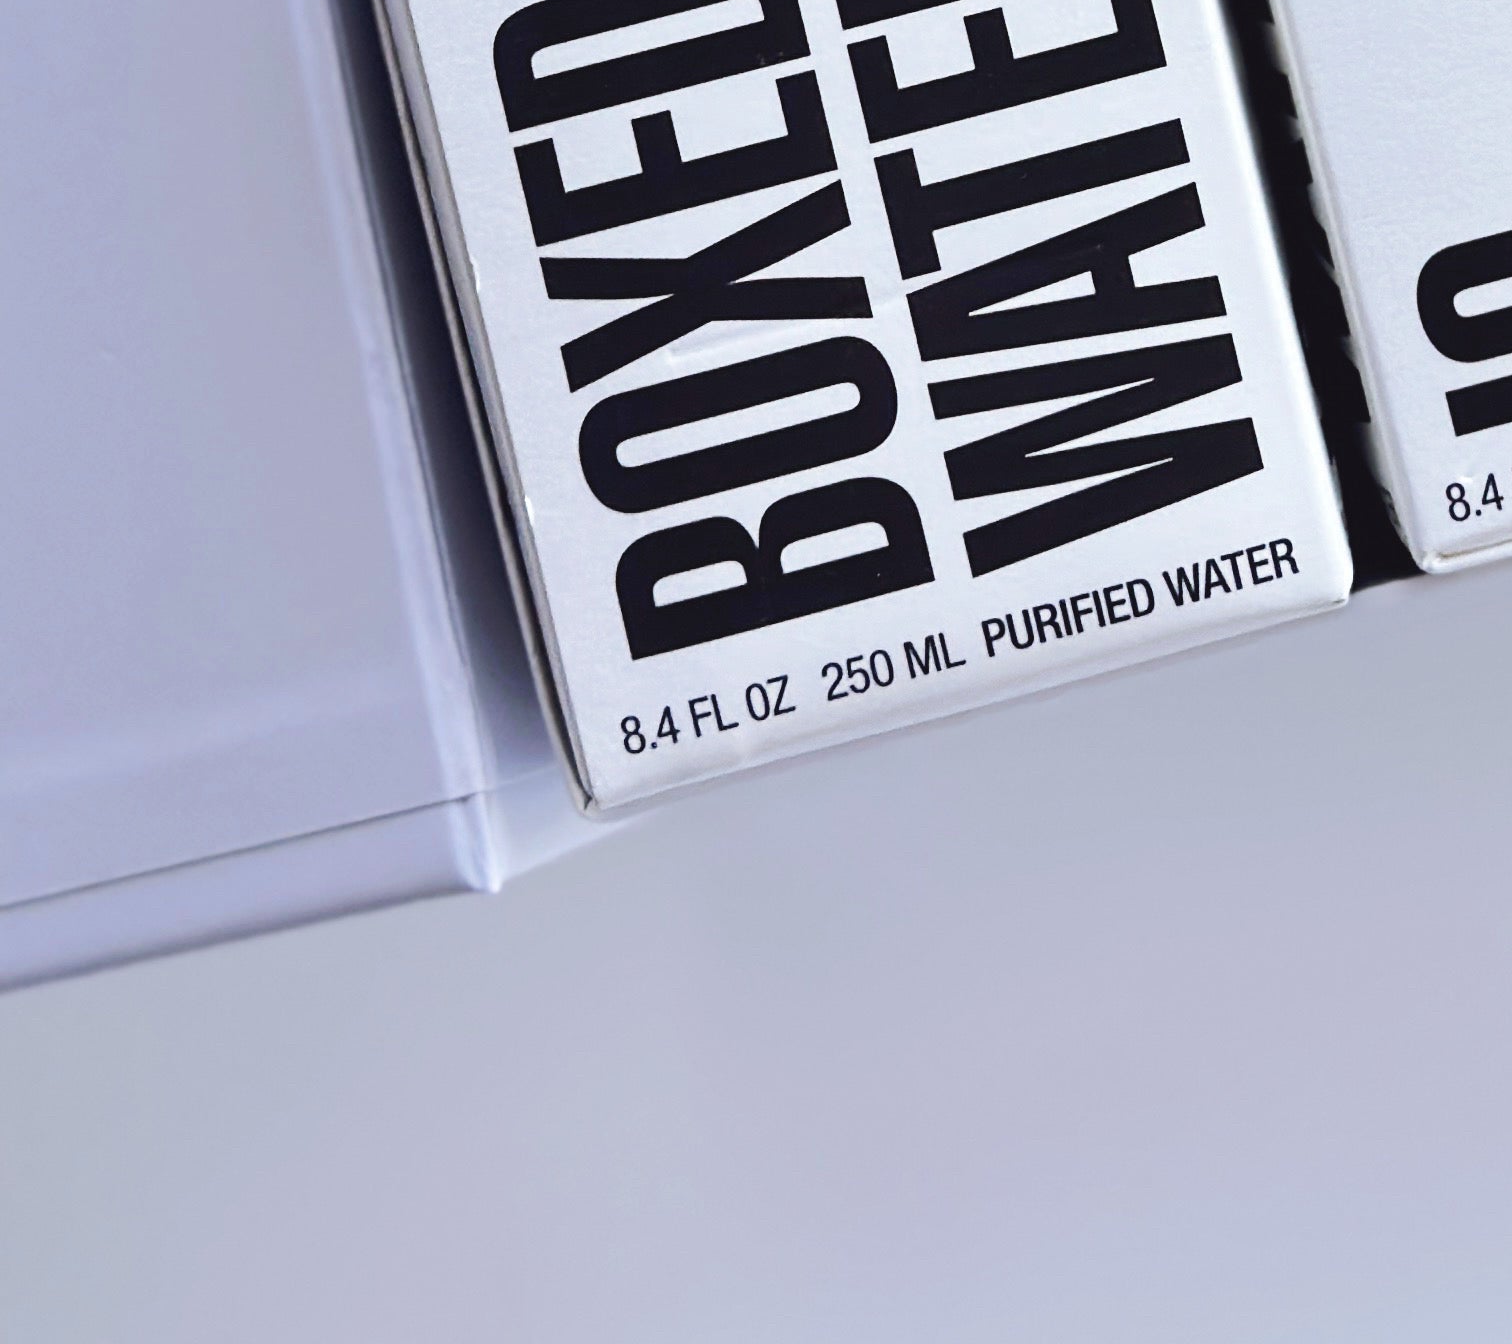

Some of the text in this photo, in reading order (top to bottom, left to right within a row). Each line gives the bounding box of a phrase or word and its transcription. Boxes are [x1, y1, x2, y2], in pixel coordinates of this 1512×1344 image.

[1445, 473, 1505, 522] 8.4
[620, 537, 1301, 755] 8.4 FL OZ 250 ML PURIFIED WATER
